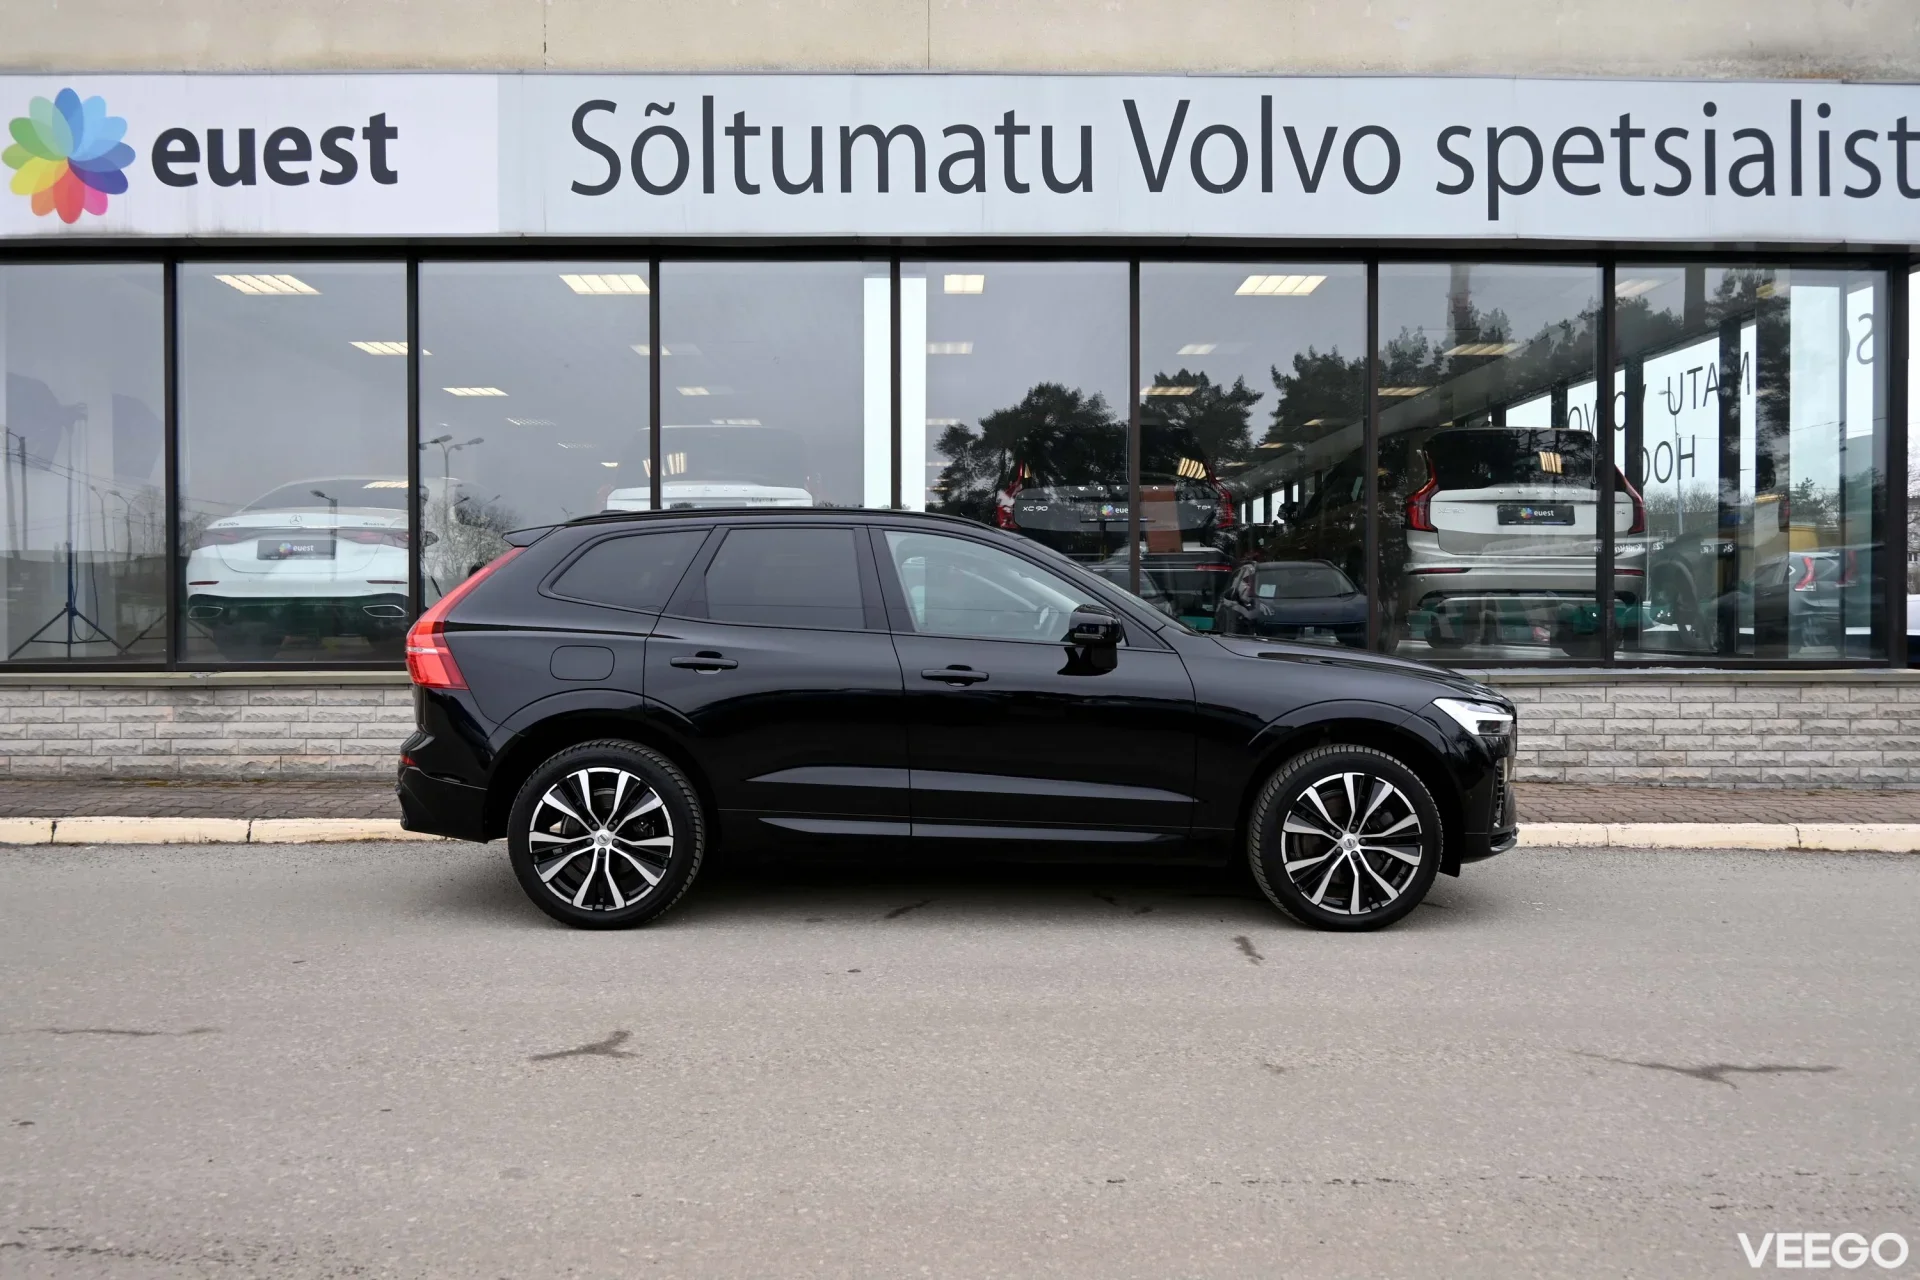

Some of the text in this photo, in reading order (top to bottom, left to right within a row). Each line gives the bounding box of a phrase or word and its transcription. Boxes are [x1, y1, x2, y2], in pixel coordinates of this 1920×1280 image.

[151, 112, 398, 187] euest
[571, 95, 1920, 221] Sõltumatu Volvo spetsialist
[1533, 509, 1555, 517] euest
[292, 543, 315, 552] euest
